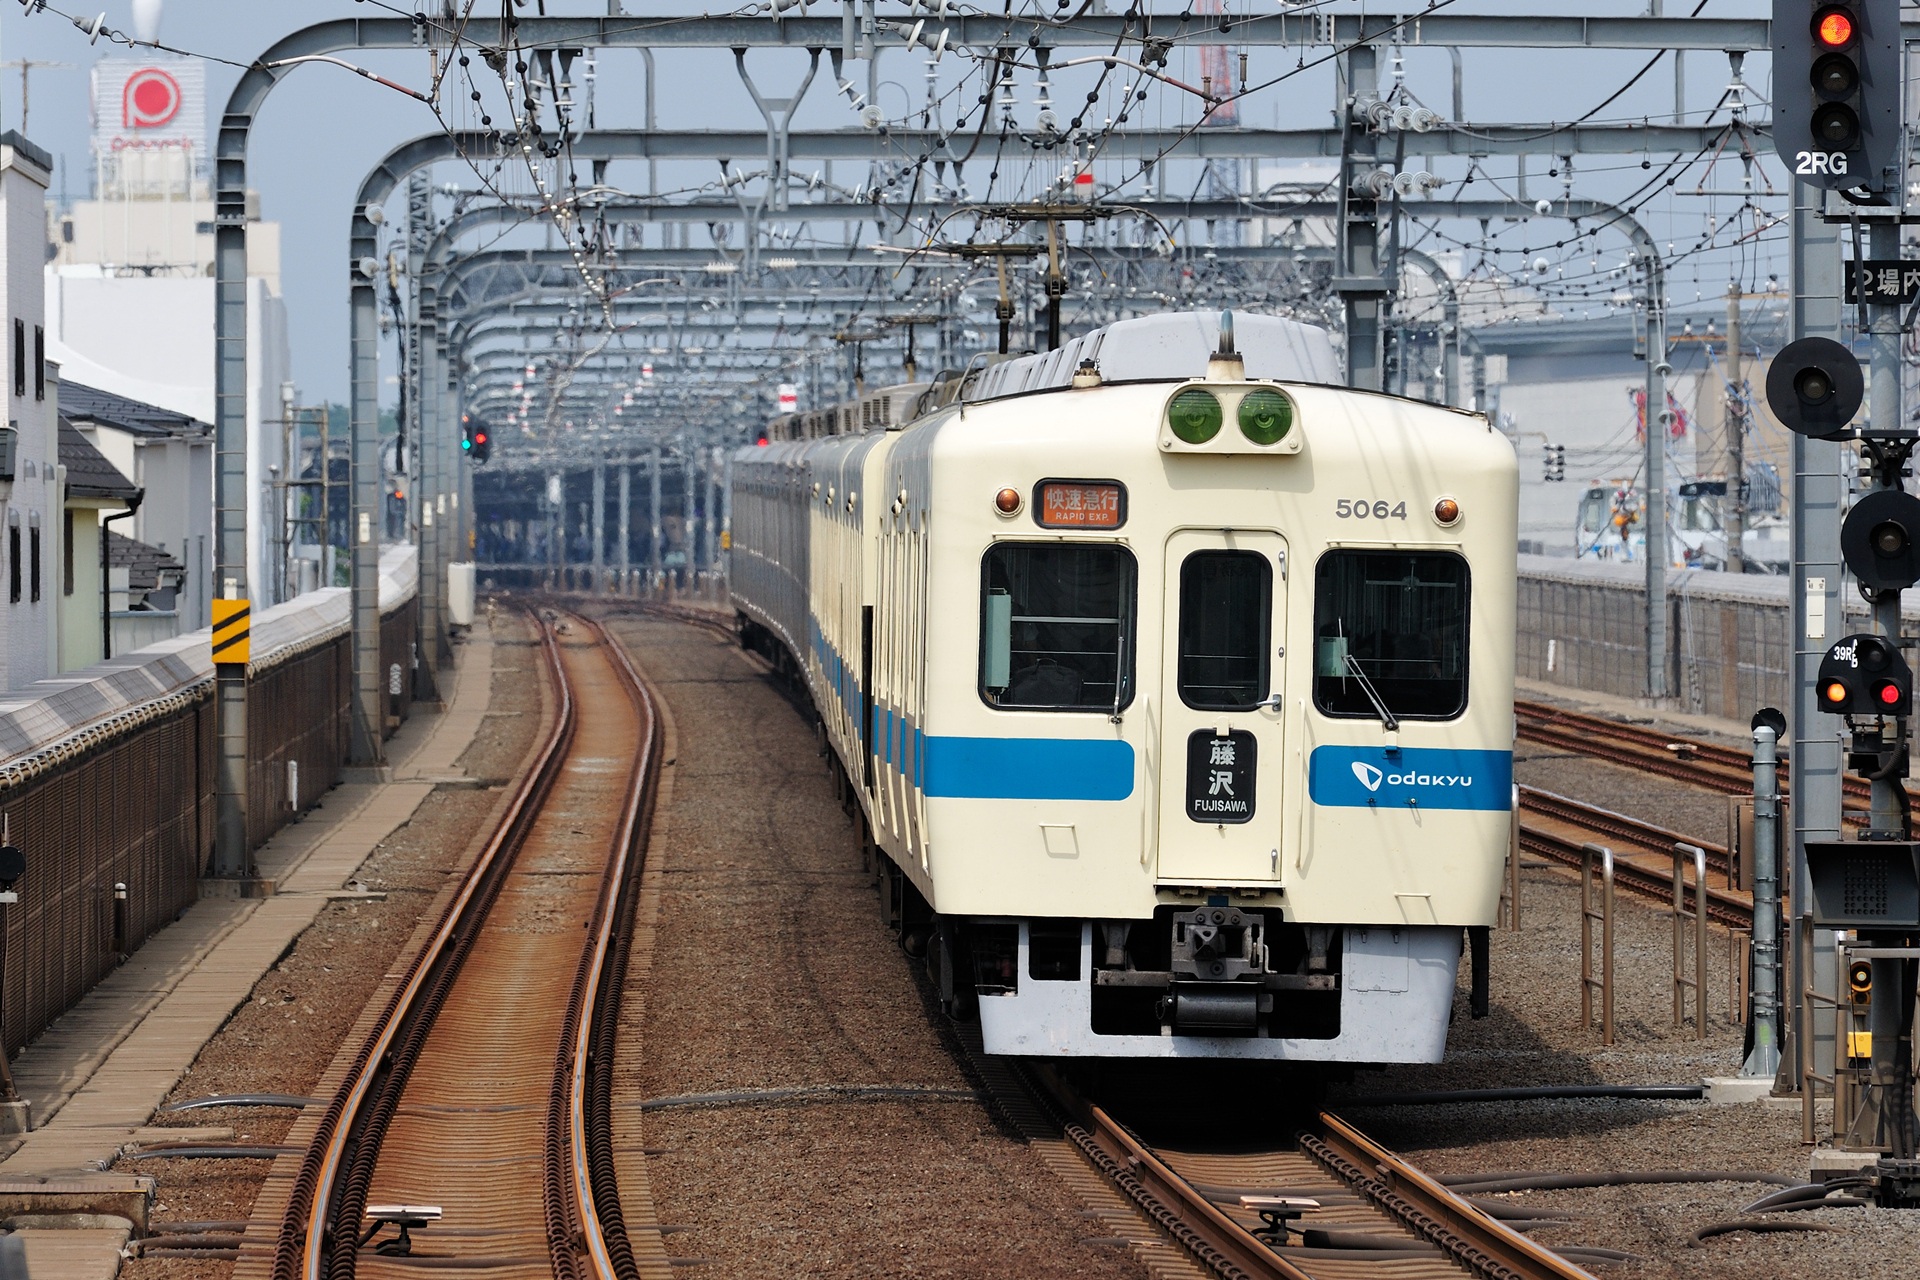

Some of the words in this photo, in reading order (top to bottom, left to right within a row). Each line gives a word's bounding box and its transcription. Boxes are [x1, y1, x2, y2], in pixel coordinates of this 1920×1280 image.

[1796, 151, 1847, 175] 2RG
[1047, 488, 1118, 511] 快速急行
[1335, 499, 1407, 521] 5064
[1055, 512, 1085, 521] RAPID
[1089, 513, 1109, 521] EXP.
[1208, 739, 1236, 796] 藤沢
[1194, 799, 1248, 812] FUJISAWA
